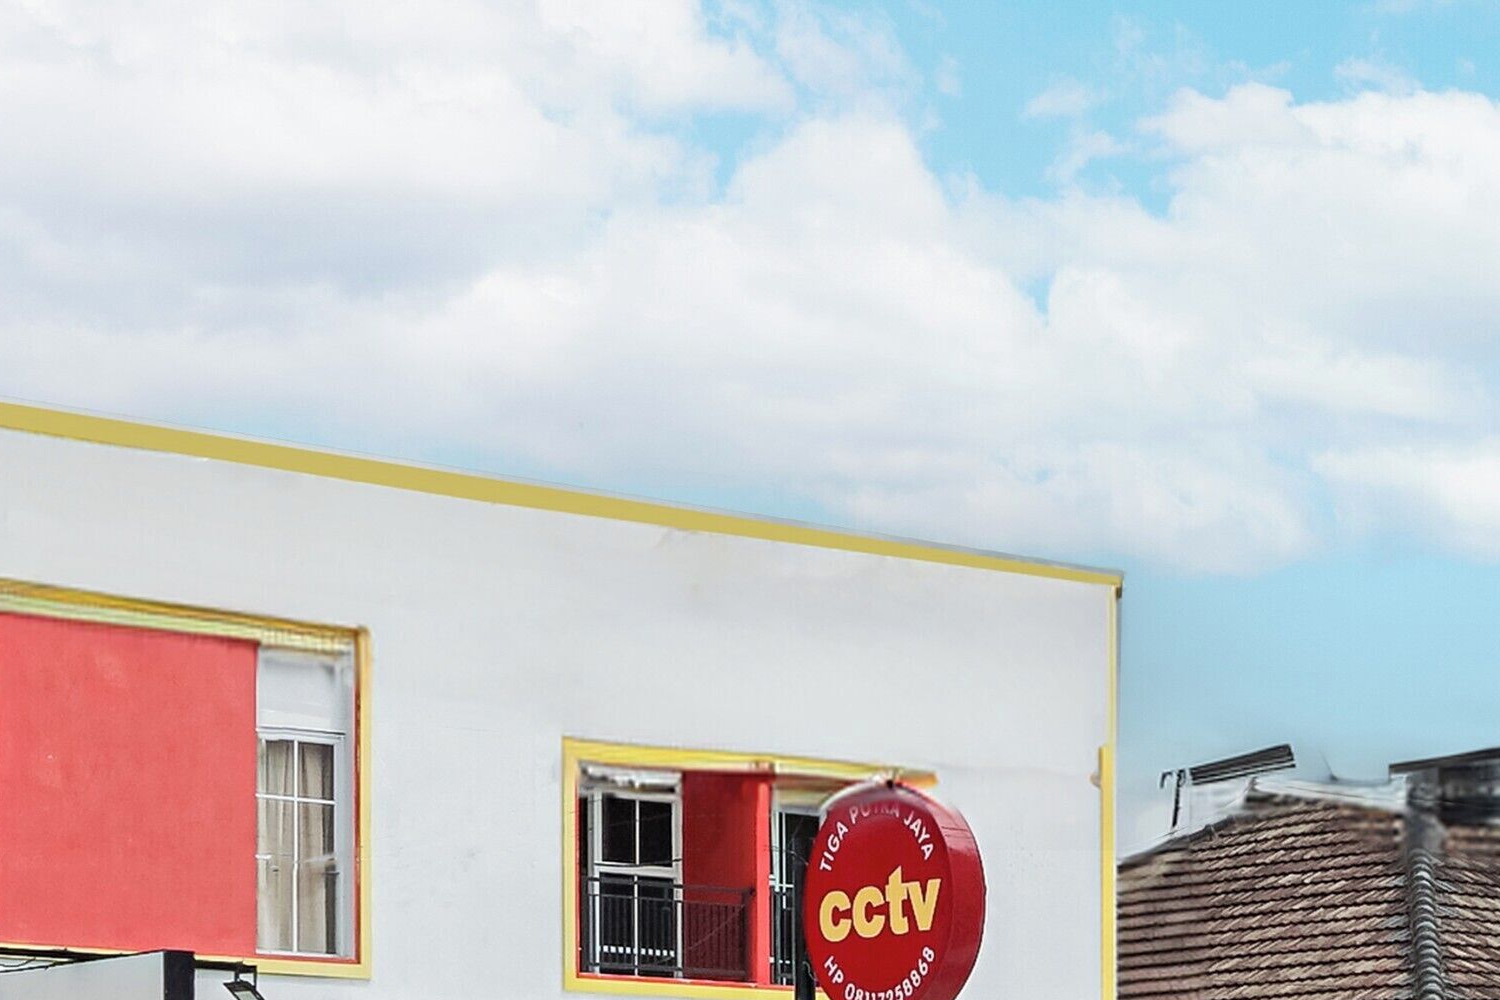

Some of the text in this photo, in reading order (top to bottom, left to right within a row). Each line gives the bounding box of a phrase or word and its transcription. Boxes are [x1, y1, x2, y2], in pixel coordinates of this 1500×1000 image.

[819, 821, 849, 872] TIGA
[903, 810, 935, 861] JAYA
[818, 865, 942, 943] cctv
[823, 955, 845, 985] HP
